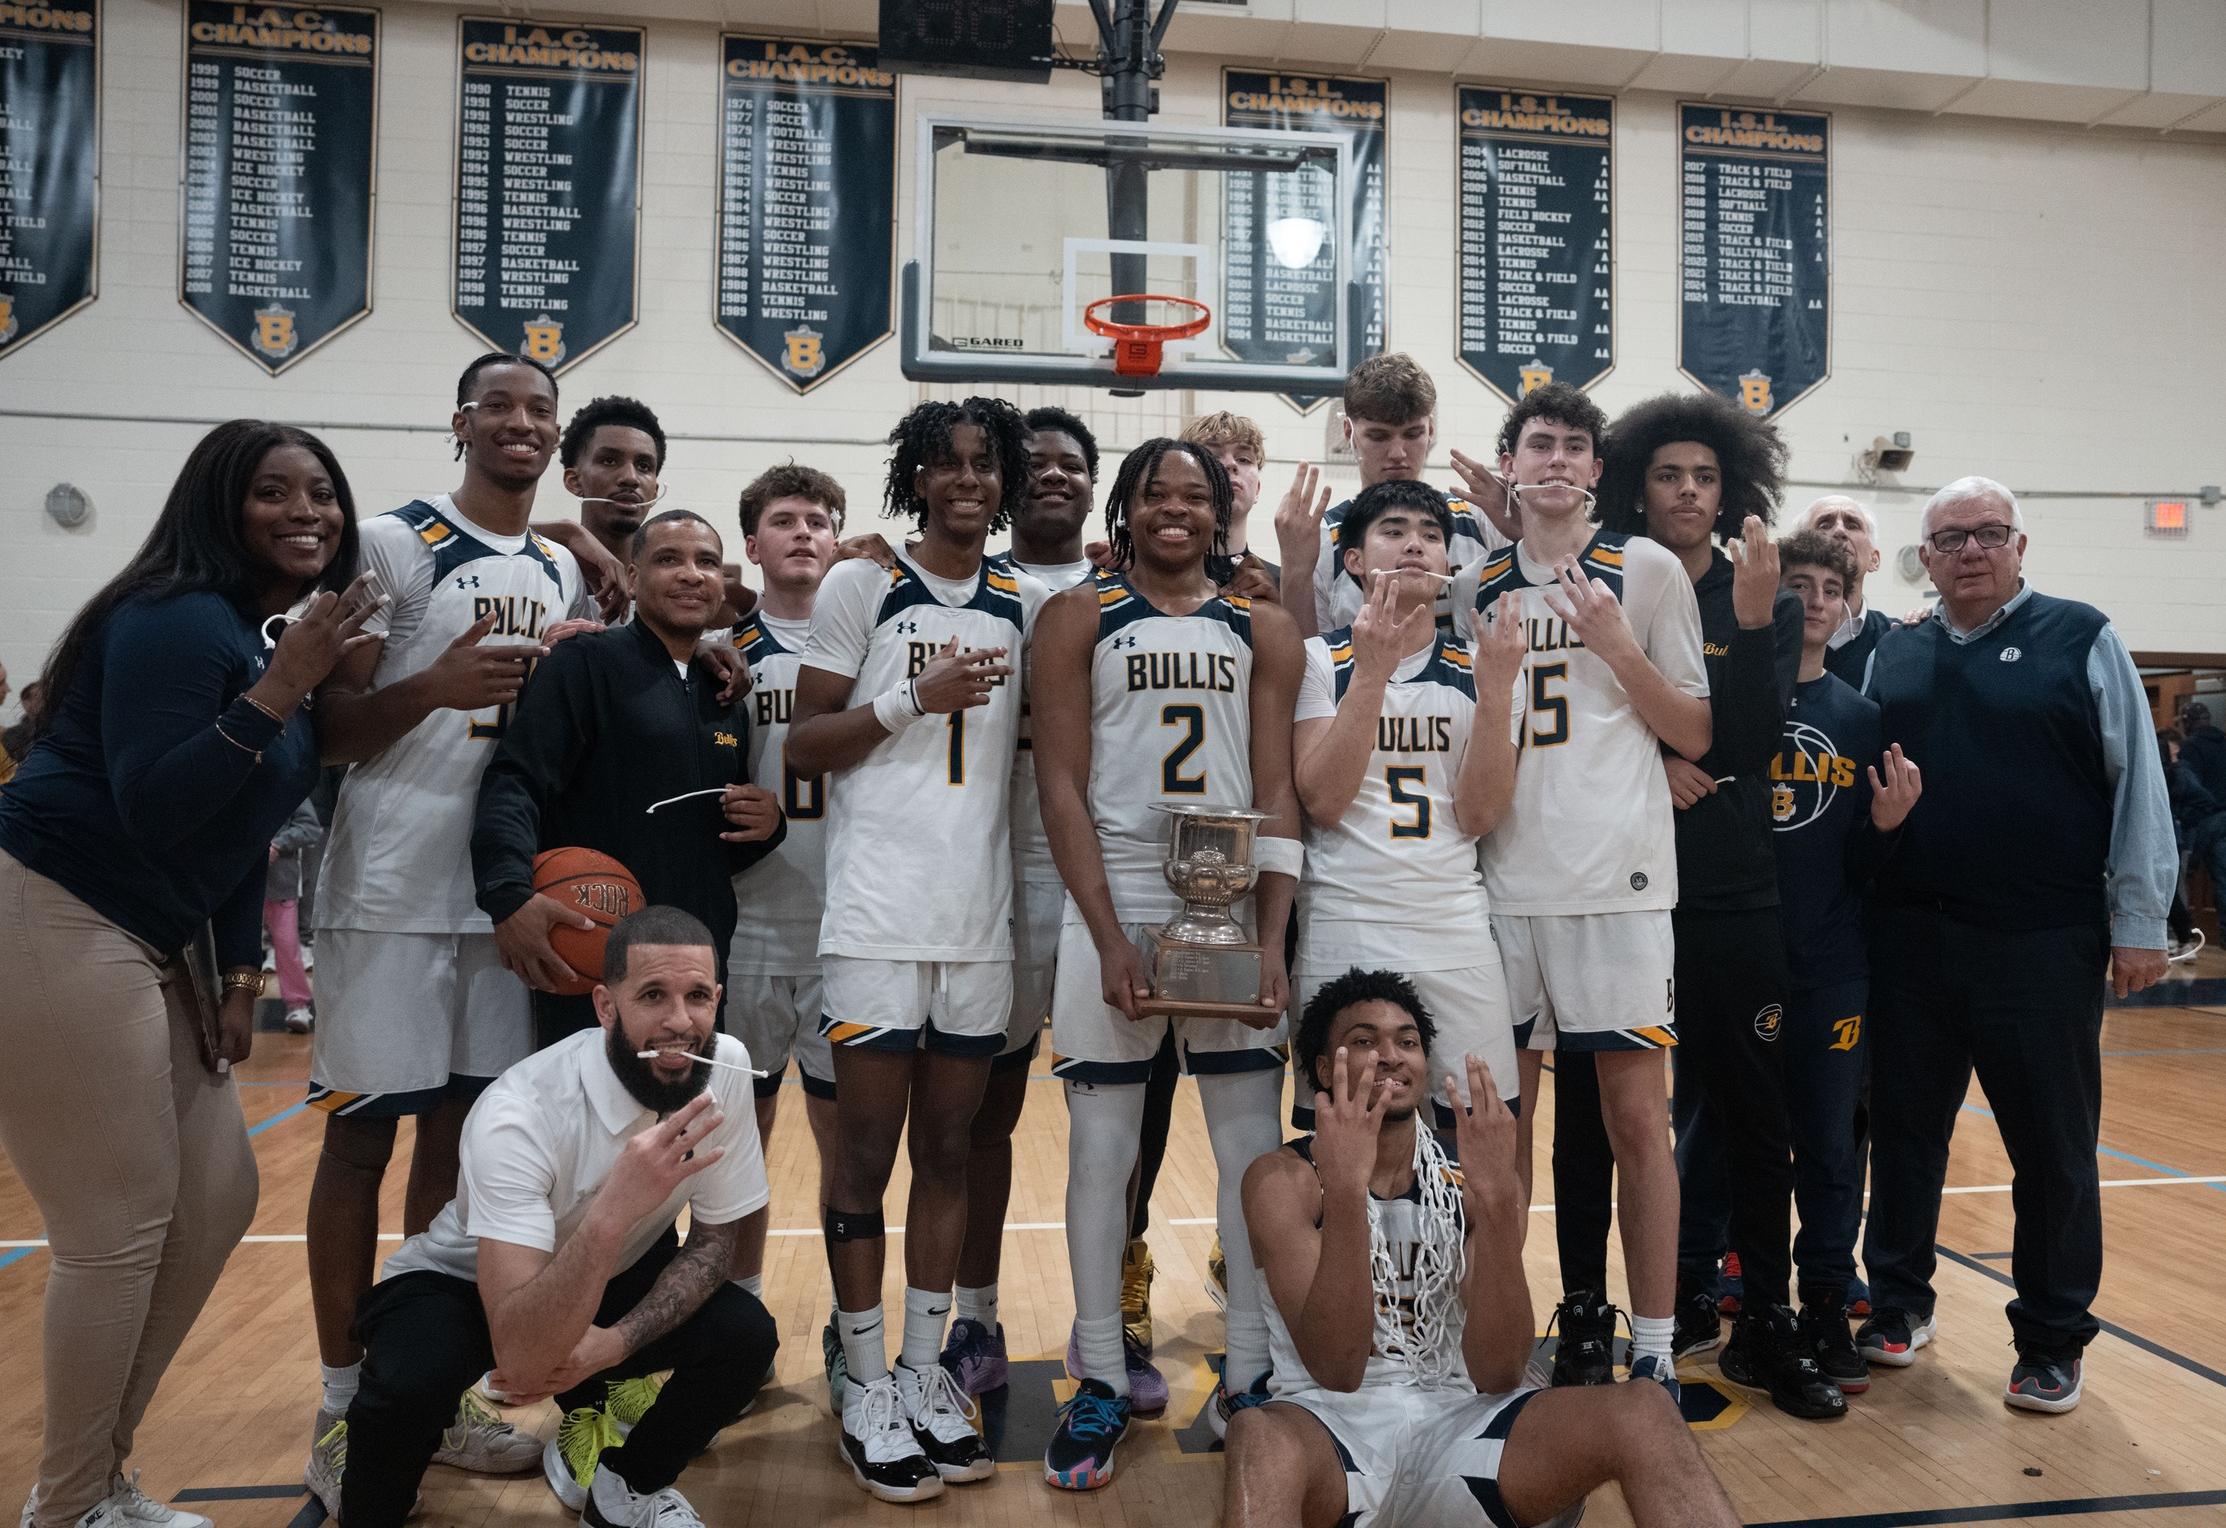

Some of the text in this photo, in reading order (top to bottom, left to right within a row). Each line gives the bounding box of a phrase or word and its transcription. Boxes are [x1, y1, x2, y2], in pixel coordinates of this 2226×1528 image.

[192, 22, 371, 53] CHAMPIONS
[504, 26, 599, 49] I.A.C.
[466, 42, 637, 71] CHAMPIONS
[766, 43, 856, 65] I.A.C.
[235, 67, 281, 79] SOCCER
[727, 58, 893, 87] CHAMPIONS
[234, 81, 316, 94] BASKETBALL
[465, 83, 550, 97] 1990 TENNIS
[234, 94, 280, 106] SOCCER
[464, 96, 549, 111] 1991 SOCCER
[767, 101, 808, 112] SOCCER
[1229, 92, 1383, 119] CHAMPIONS
[1501, 95, 1571, 115] I.S.L.
[234, 108, 316, 122] BASKETBALL
[464, 110, 573, 125] 1991 WRESTLING
[767, 114, 808, 125] SOCCER
[1462, 108, 1609, 136] CHAMPIONS
[464, 123, 548, 137] 1992 SOCCER
[766, 127, 825, 139] FOOTBALL
[463, 136, 548, 150] 1993 SOCCER
[1685, 126, 1823, 152] CHAMPIONS
[766, 140, 832, 152] WRESTLING
[463, 150, 572, 165] 1993 WRESTLING
[766, 153, 831, 165] WRESTLING
[1498, 149, 1549, 160] LACROSSE
[232, 162, 304, 176] ICE HOCKEY
[463, 163, 547, 177] 1994 SOCCER
[765, 166, 808, 177] TENNIS
[1498, 161, 1550, 172] SOFTBALL
[1719, 164, 1750, 175] TRACK
[1753, 166, 1760, 175] &
[1764, 167, 1792, 177] FIELD
[462, 176, 572, 191] 1995 WRESTLING
[765, 179, 831, 191] WRESTLING
[1498, 173, 1565, 185] BASKETBALL
[462, 189, 547, 203] 1995 TENNIS
[1498, 185, 1536, 196] TENNIS
[1719, 188, 1766, 199] LACROSSE
[765, 192, 806, 203] SOCCER
[1498, 198, 1536, 209] TENNIS
[462, 203, 581, 218] 1996 BASKETBALL
[764, 205, 830, 217] WRESTLING
[1719, 199, 1768, 211] SOFTBALL
[231, 217, 278, 229] TENNIS
[1498, 210, 1529, 220] FIELD
[1532, 212, 1572, 223] HOCKEY
[1719, 211, 1754, 222] TENNIS
[461, 216, 571, 231] 1996 WRESTLING
[764, 218, 830, 230] WRESTLING
[1498, 222, 1536, 233] SOCCER
[1719, 223, 1753, 234] SOCCER
[461, 229, 546, 243] 1996 TENNIS
[764, 230, 805, 242] SOCCER
[1498, 234, 1565, 247] BASKETBALL
[461, 243, 545, 256] 1997 SOCCER
[763, 243, 829, 256] WRESTLING
[1719, 247, 1781, 259] VOLLEYBALL
[230, 258, 302, 271] ICE HOCKEY
[460, 256, 580, 271] 1997 BASKETBALL
[763, 256, 829, 269] WRESTLING
[460, 269, 569, 284] 1997 WRESTLING
[763, 269, 828, 282] WRESTLING
[1498, 271, 1577, 284] TRACK & FIELD
[229, 285, 311, 299] BASKETBALL
[460, 282, 545, 296] 1998 TENNIS
[762, 282, 839, 295] BASKETBALL
[459, 296, 569, 310] 1998 WRESTLING
[762, 295, 805, 307] TENNIS
[1265, 293, 1305, 305] SOCCER
[1719, 294, 1781, 307] VOLLEYBALL
[762, 308, 827, 321] WRESTLING
[1265, 306, 1305, 318] TENNIS
[259, 313, 294, 349] B
[525, 325, 561, 360] B
[970, 338, 1023, 347] GARED
[788, 338, 823, 367] B
[1739, 378, 1771, 410] B
[1126, 652, 1235, 693] BULLIS
[1373, 715, 1452, 752] ULLIS
[1161, 703, 1206, 795] 2
[1385, 764, 1432, 840] 5
[1772, 789, 1795, 817] B
[575, 884, 629, 918] ROCK
